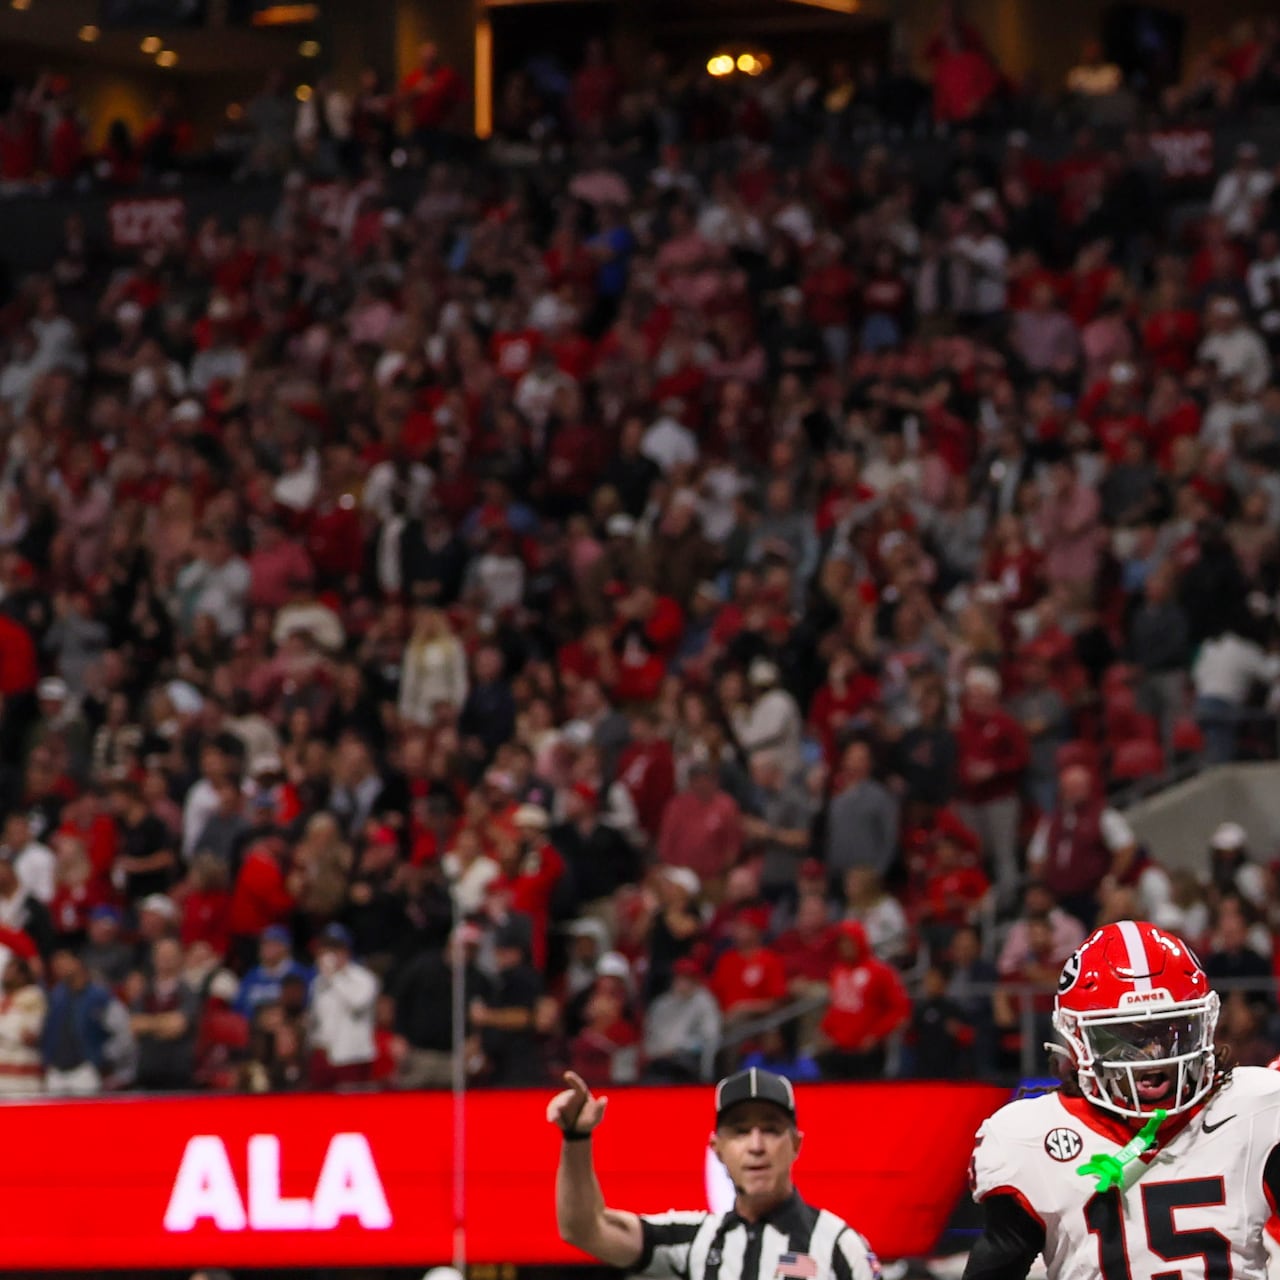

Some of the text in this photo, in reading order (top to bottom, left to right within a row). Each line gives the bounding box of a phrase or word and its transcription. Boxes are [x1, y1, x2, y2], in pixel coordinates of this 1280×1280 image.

[1127, 993, 1165, 1004] DAWGS
[1047, 1130, 1081, 1160] SEC
[163, 1132, 393, 1231] ALA
